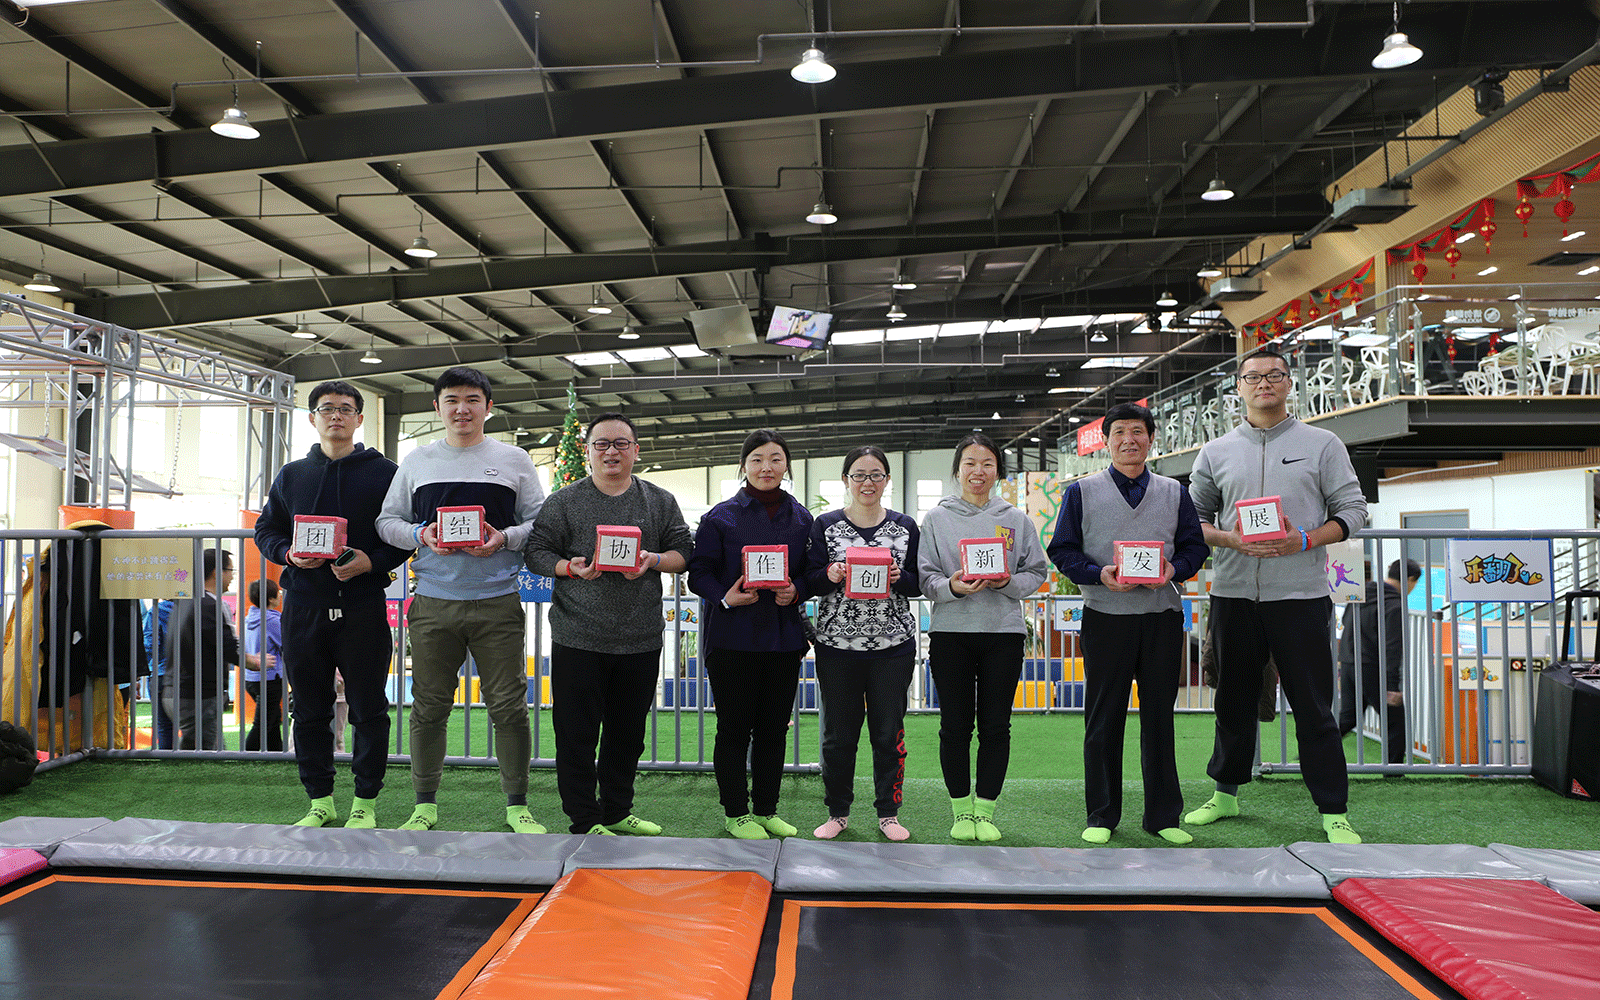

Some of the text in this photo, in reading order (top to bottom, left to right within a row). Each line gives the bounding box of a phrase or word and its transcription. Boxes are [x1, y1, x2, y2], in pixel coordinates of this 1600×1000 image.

[449, 515, 471, 536] 结
[1248, 507, 1270, 529] 展
[307, 527, 326, 547] 团
[609, 539, 630, 560] 协
[974, 549, 995, 569] 新
[755, 552, 776, 575] 作
[1132, 551, 1153, 571] 发
[860, 569, 881, 590] 创
